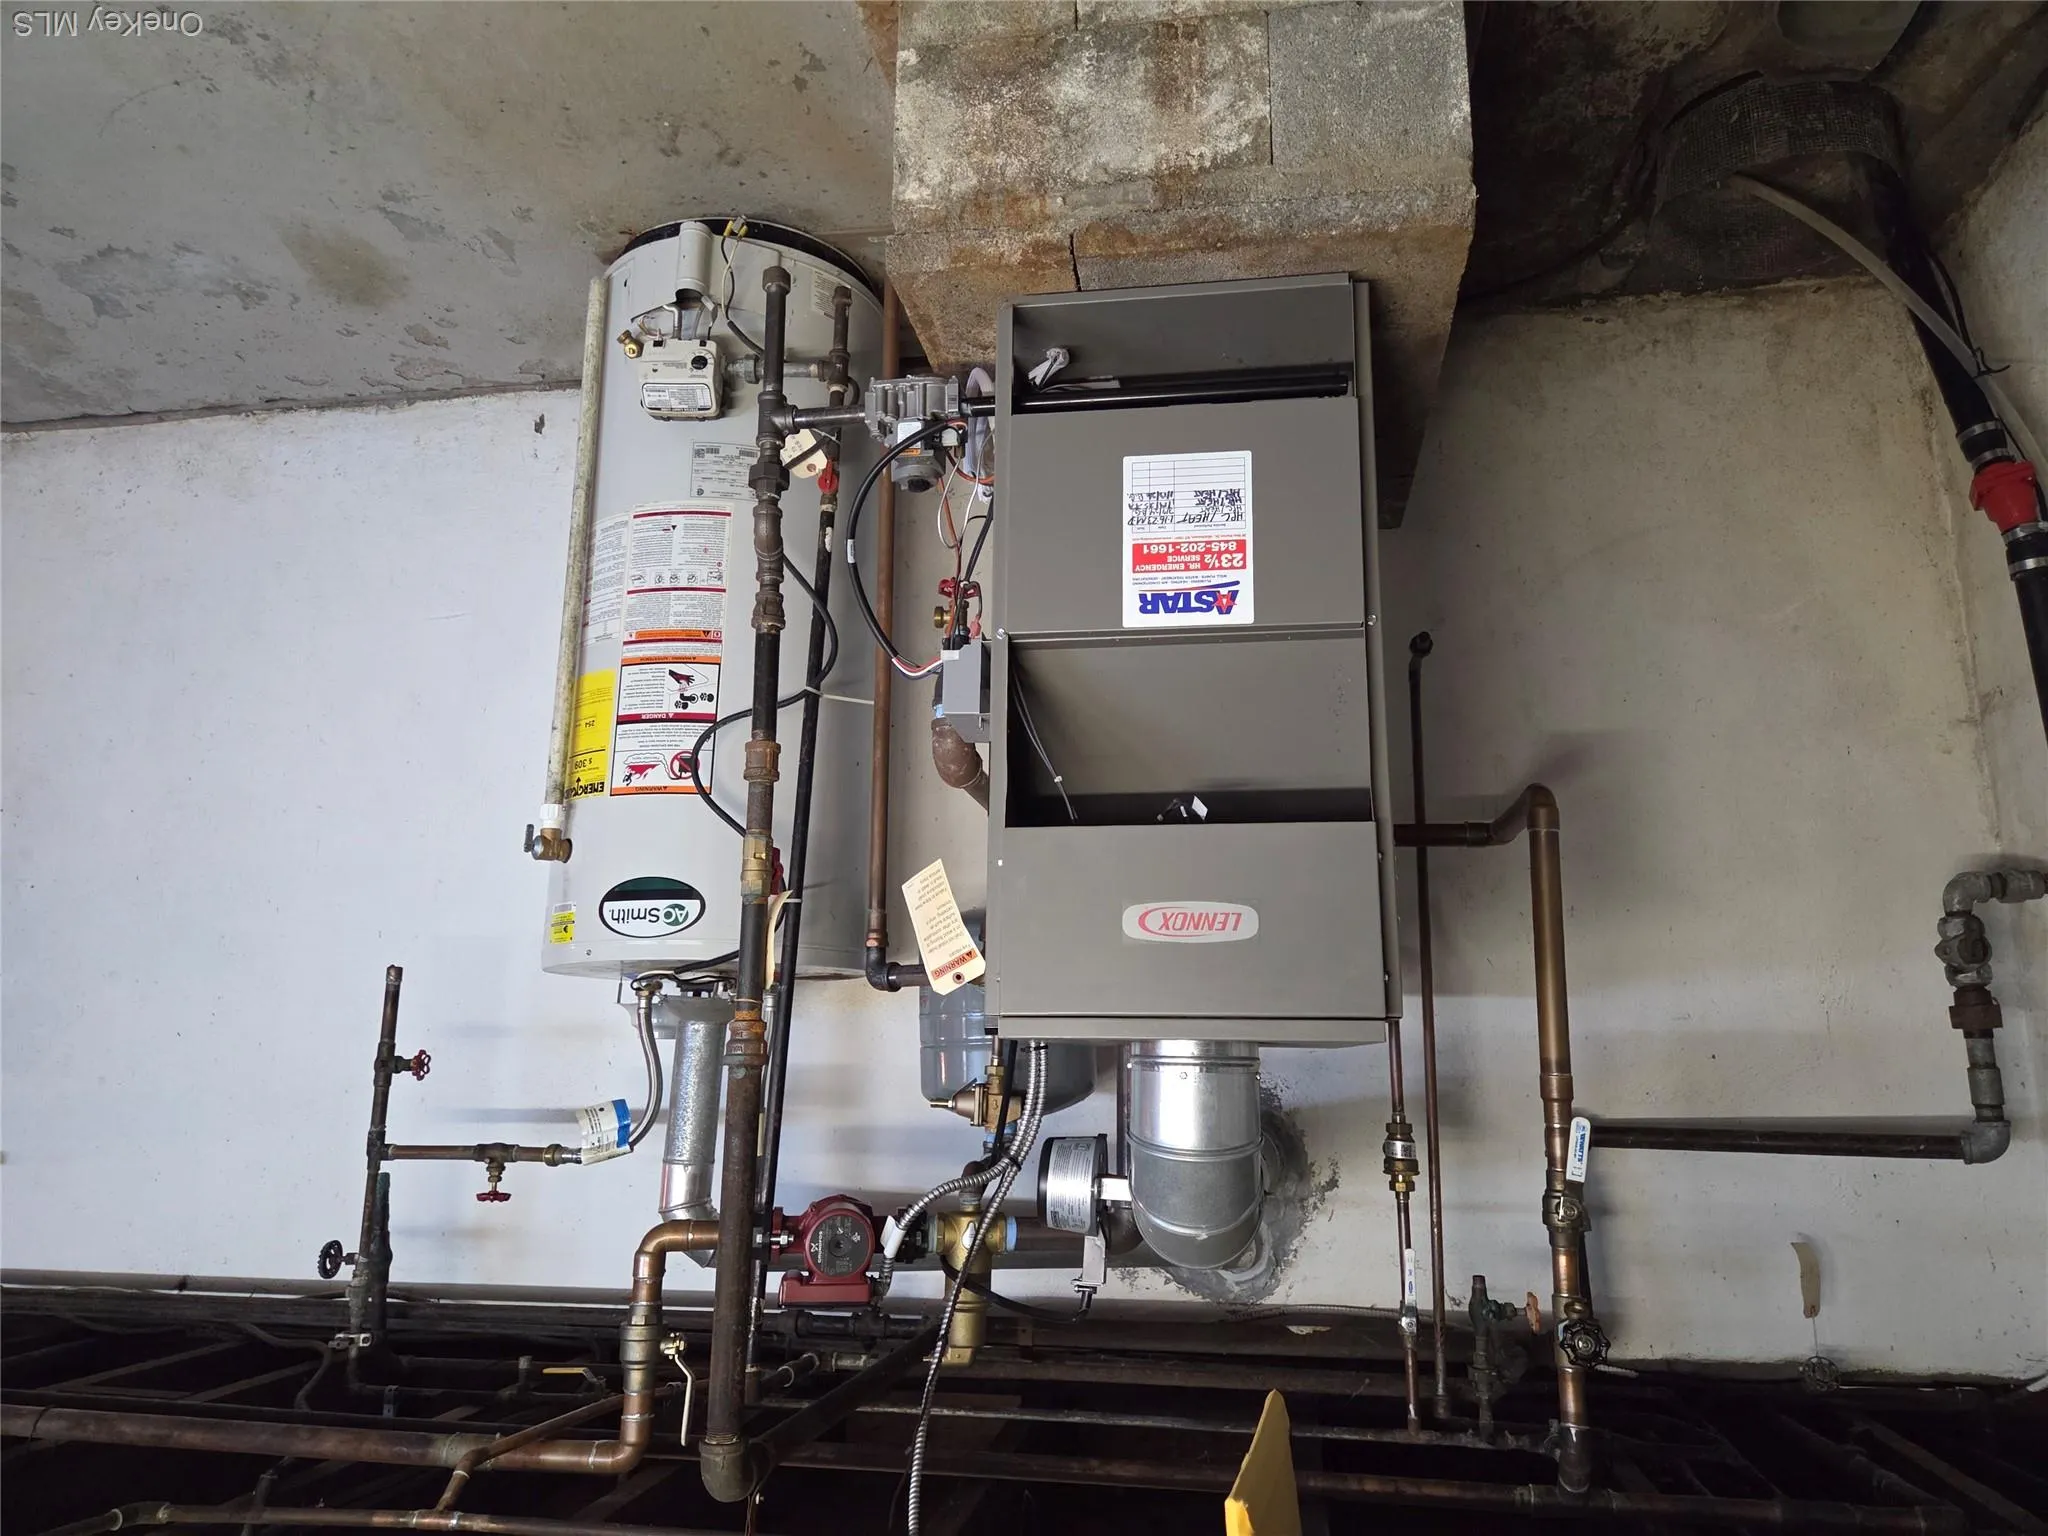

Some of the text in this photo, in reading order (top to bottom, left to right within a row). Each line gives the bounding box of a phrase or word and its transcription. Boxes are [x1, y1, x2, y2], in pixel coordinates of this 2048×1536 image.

[1142, 541, 1237, 554] 845-202-1661
[1167, 554, 1201, 562] SERVICE
[1135, 563, 1184, 571] EMERGENCY
[1187, 562, 1201, 570] HR.
[1138, 590, 1239, 614] ASTAR
[611, 908, 660, 924] Smith
[1158, 912, 1242, 932] LENNOX
[933, 955, 968, 978] WARNING
